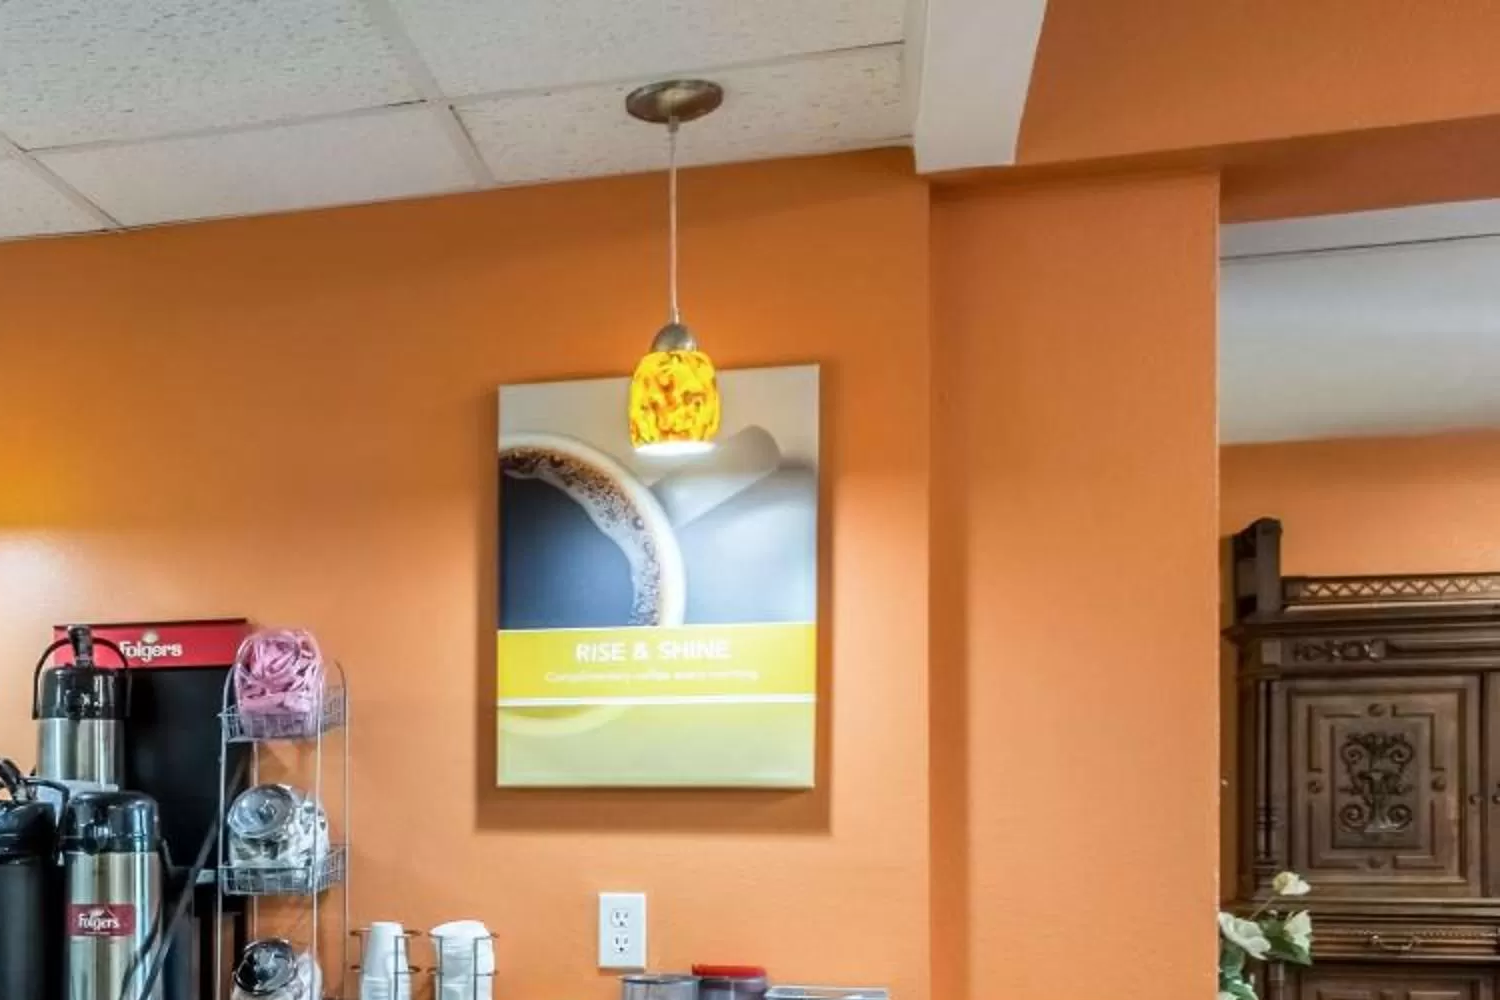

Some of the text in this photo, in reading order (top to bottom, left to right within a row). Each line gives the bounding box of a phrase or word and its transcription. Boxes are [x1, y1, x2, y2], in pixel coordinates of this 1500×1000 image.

[119, 640, 183, 663] Folgers
[576, 639, 732, 664] RISE & SHINE
